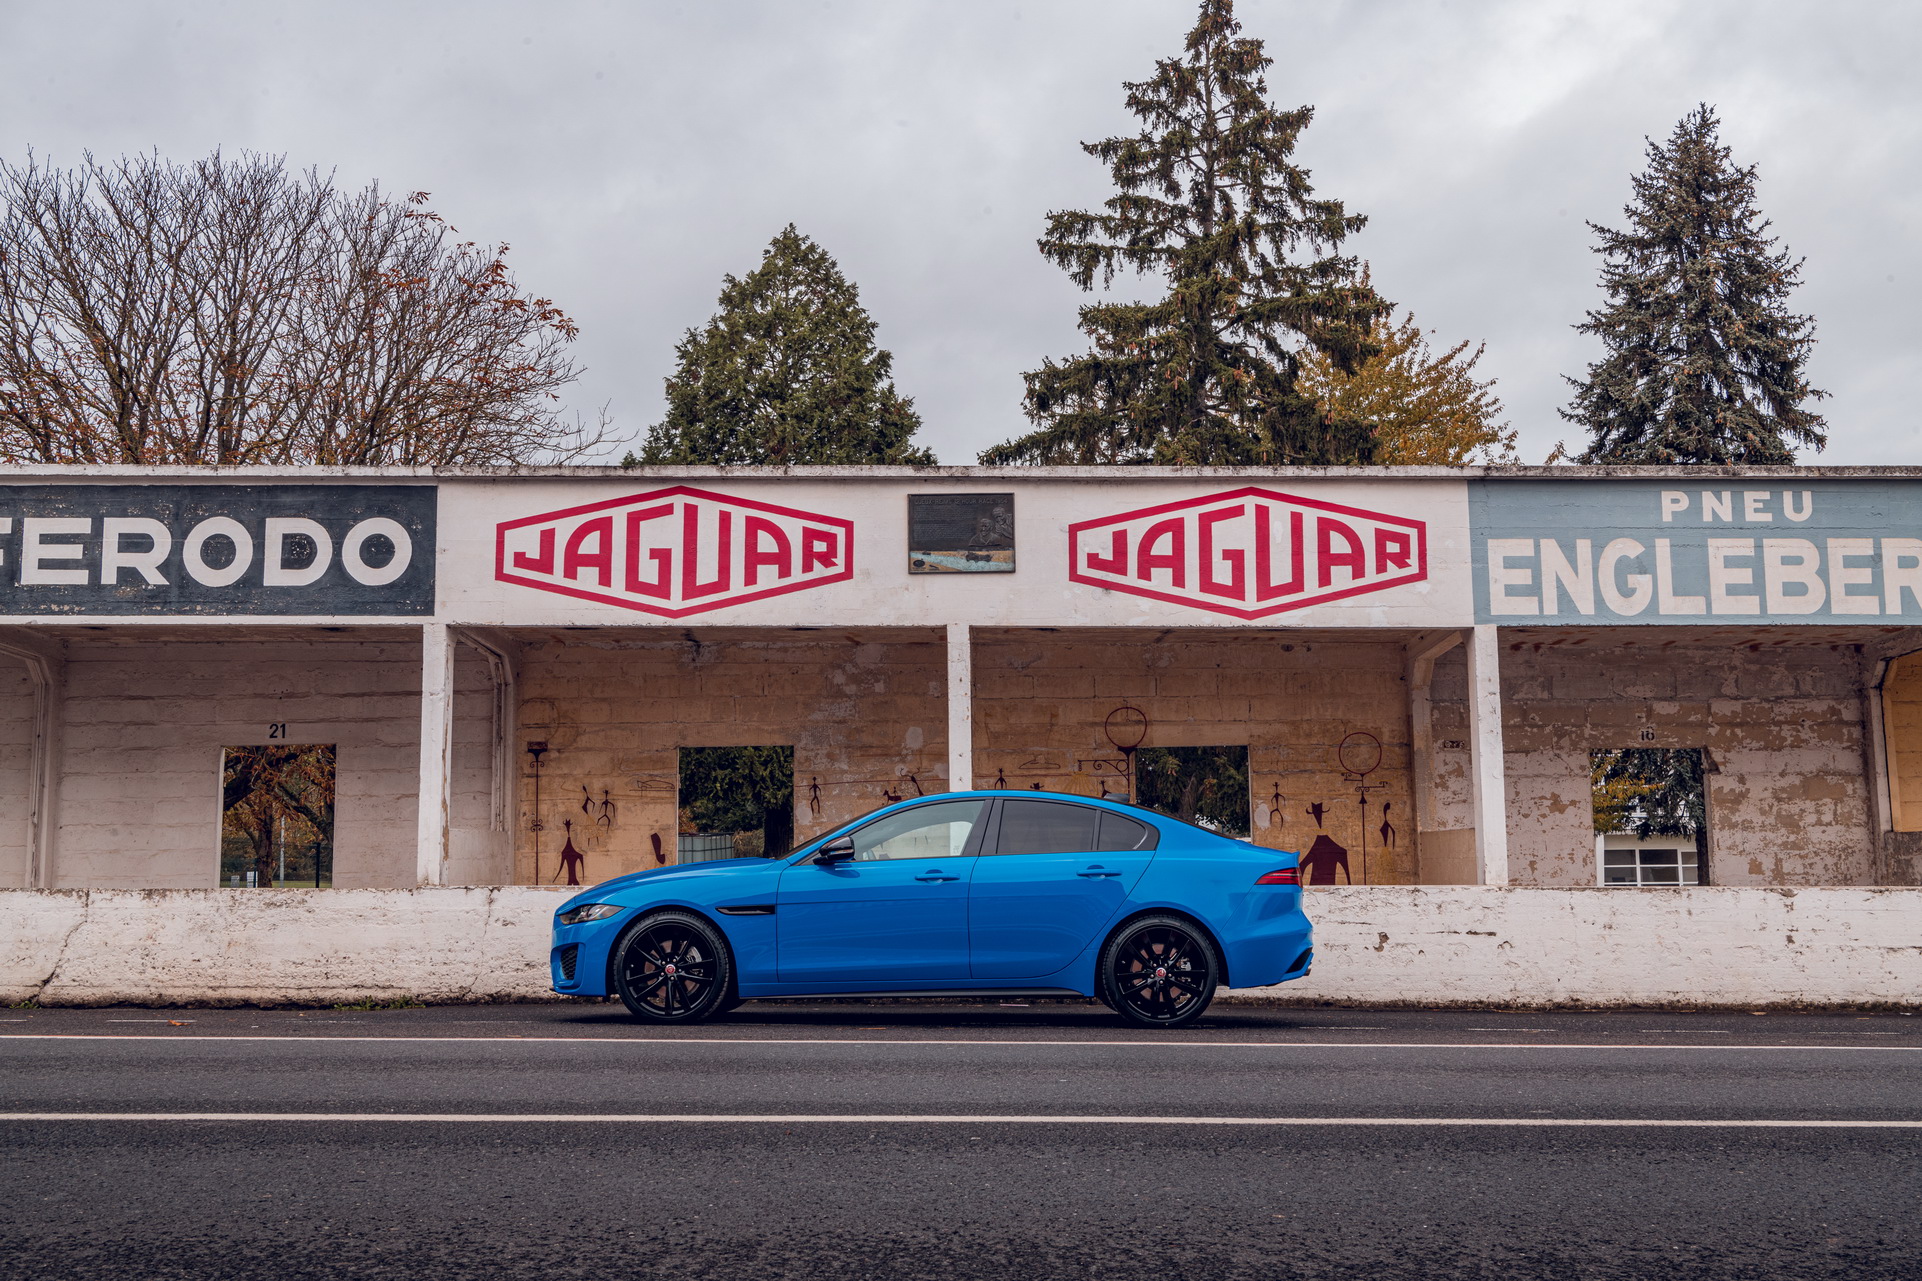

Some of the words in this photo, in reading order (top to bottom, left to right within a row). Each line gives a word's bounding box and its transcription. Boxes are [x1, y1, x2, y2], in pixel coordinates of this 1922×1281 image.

[1660, 490, 1813, 522] PNEU
[0, 516, 413, 587] ERODO
[513, 502, 839, 602] JAGUAR
[1086, 503, 1412, 603] JAGUAR
[1487, 537, 1922, 617] ENGLEBER
[269, 723, 286, 739] 21
